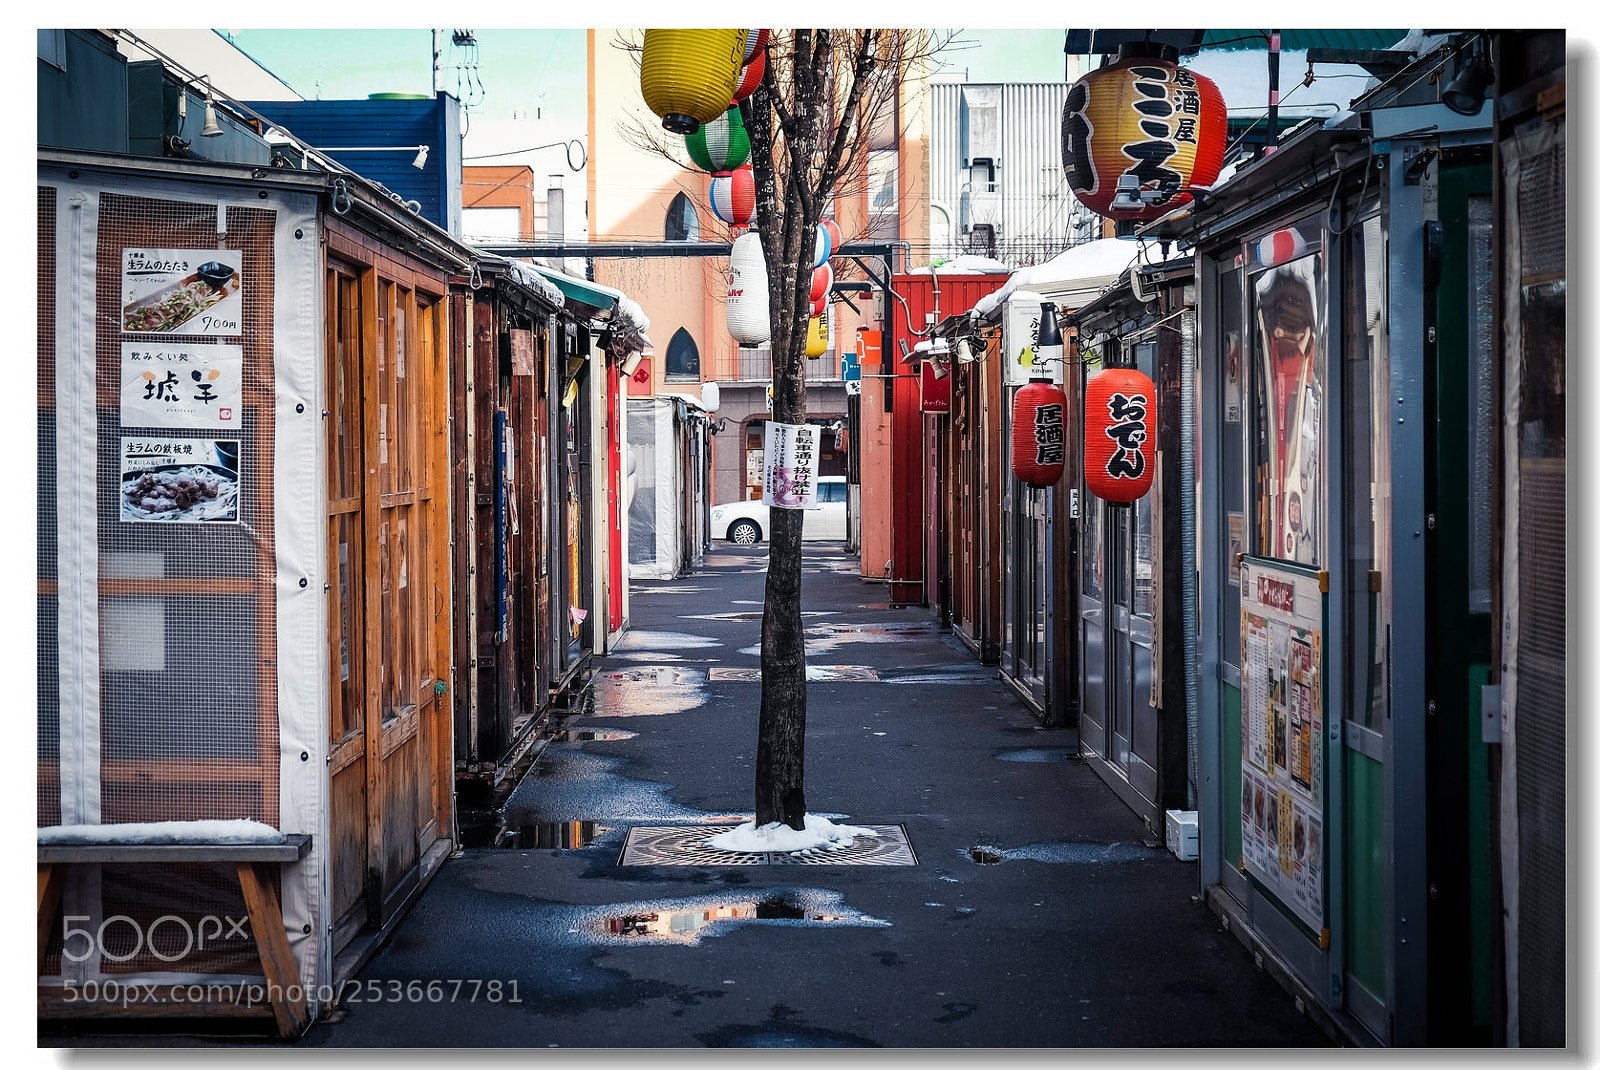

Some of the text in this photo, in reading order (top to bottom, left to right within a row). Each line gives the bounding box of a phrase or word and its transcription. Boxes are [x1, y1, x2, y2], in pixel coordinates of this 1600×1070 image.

[1172, 69, 1200, 145] 居酒屋
[127, 259, 189, 271] 生ラムのたたき
[202, 316, 237, 332] 700円
[131, 351, 189, 361] 飲みくい処
[126, 442, 193, 455] 生ラムの鉄板焼
[1035, 403, 1064, 465] 居酒屋
[1105, 392, 1148, 480] おでん
[791, 429, 813, 502] 自転車通り抜け禁止！
